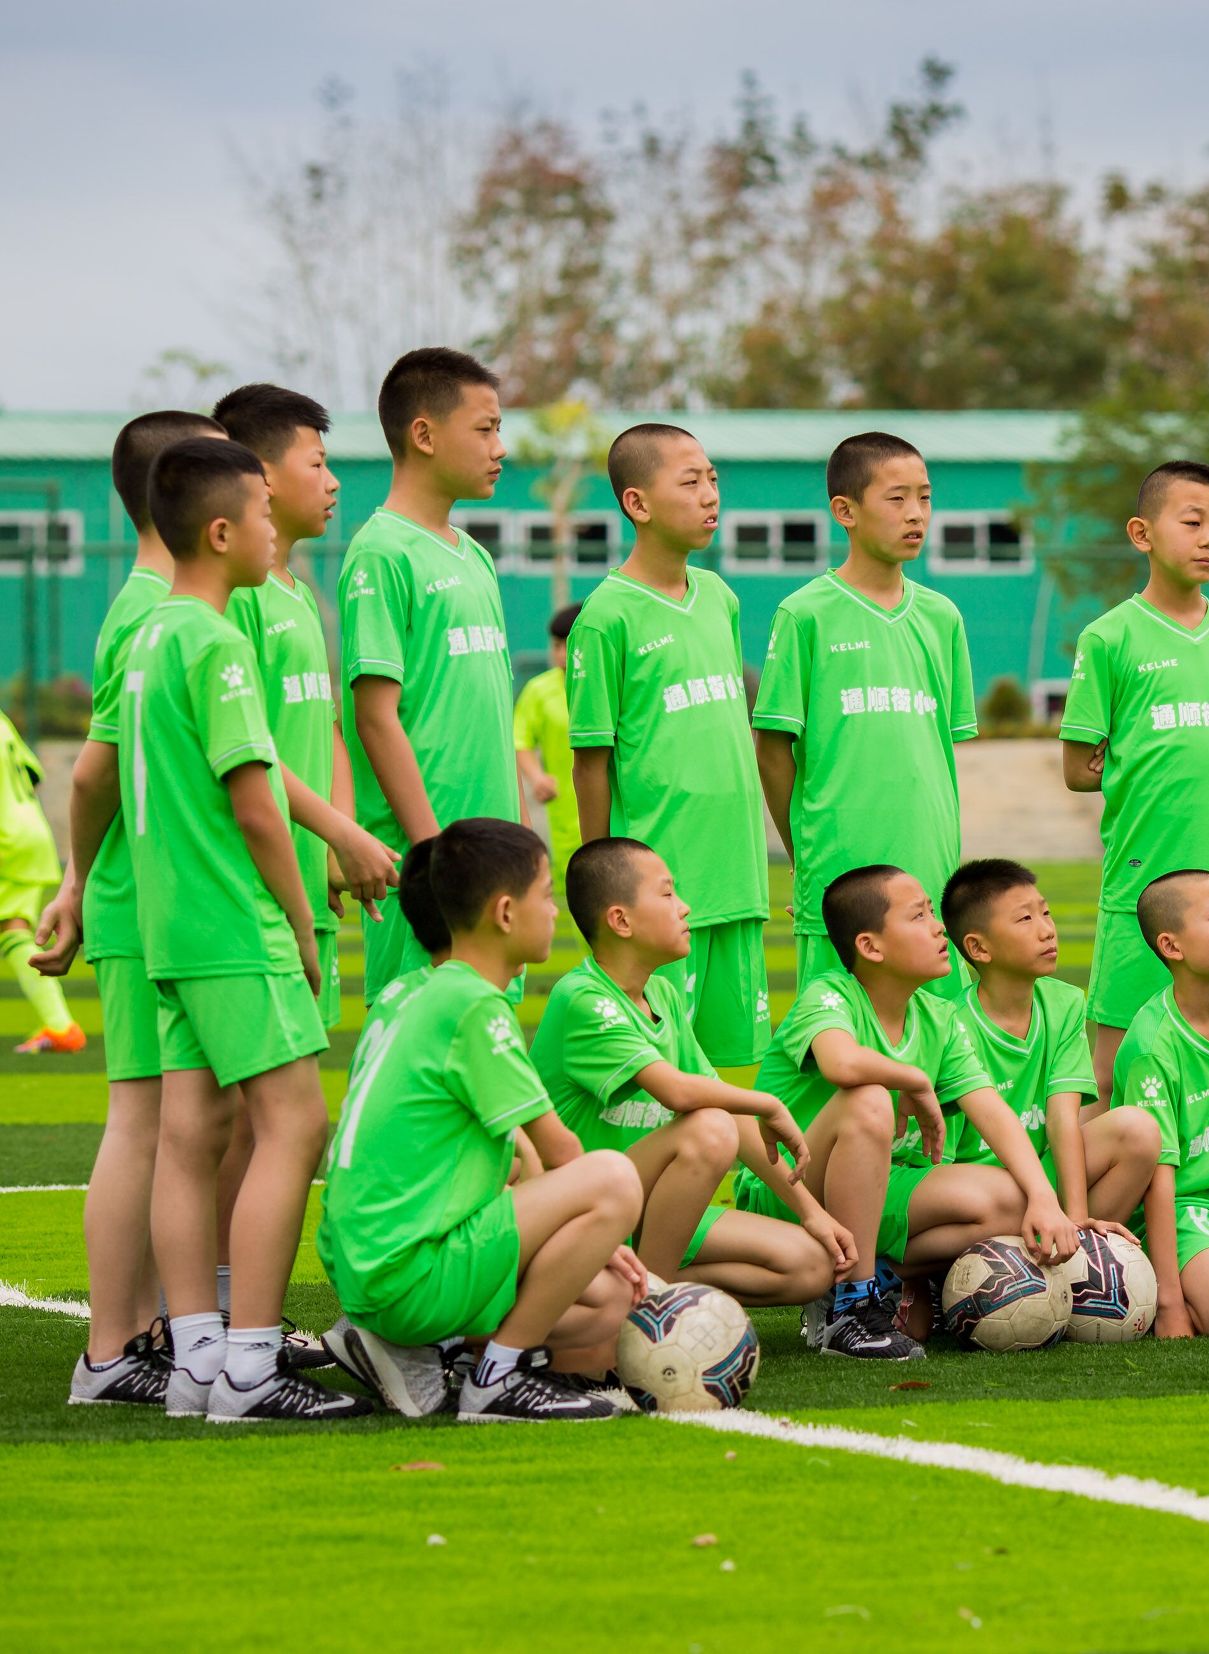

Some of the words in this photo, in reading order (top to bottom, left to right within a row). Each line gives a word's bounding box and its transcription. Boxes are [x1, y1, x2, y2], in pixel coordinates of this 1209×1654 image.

[638, 634, 675, 656] KELME
[830, 640, 871, 653] KELME
[1138, 658, 1178, 673] KELME
[1137, 1099, 1167, 1108] KELME
